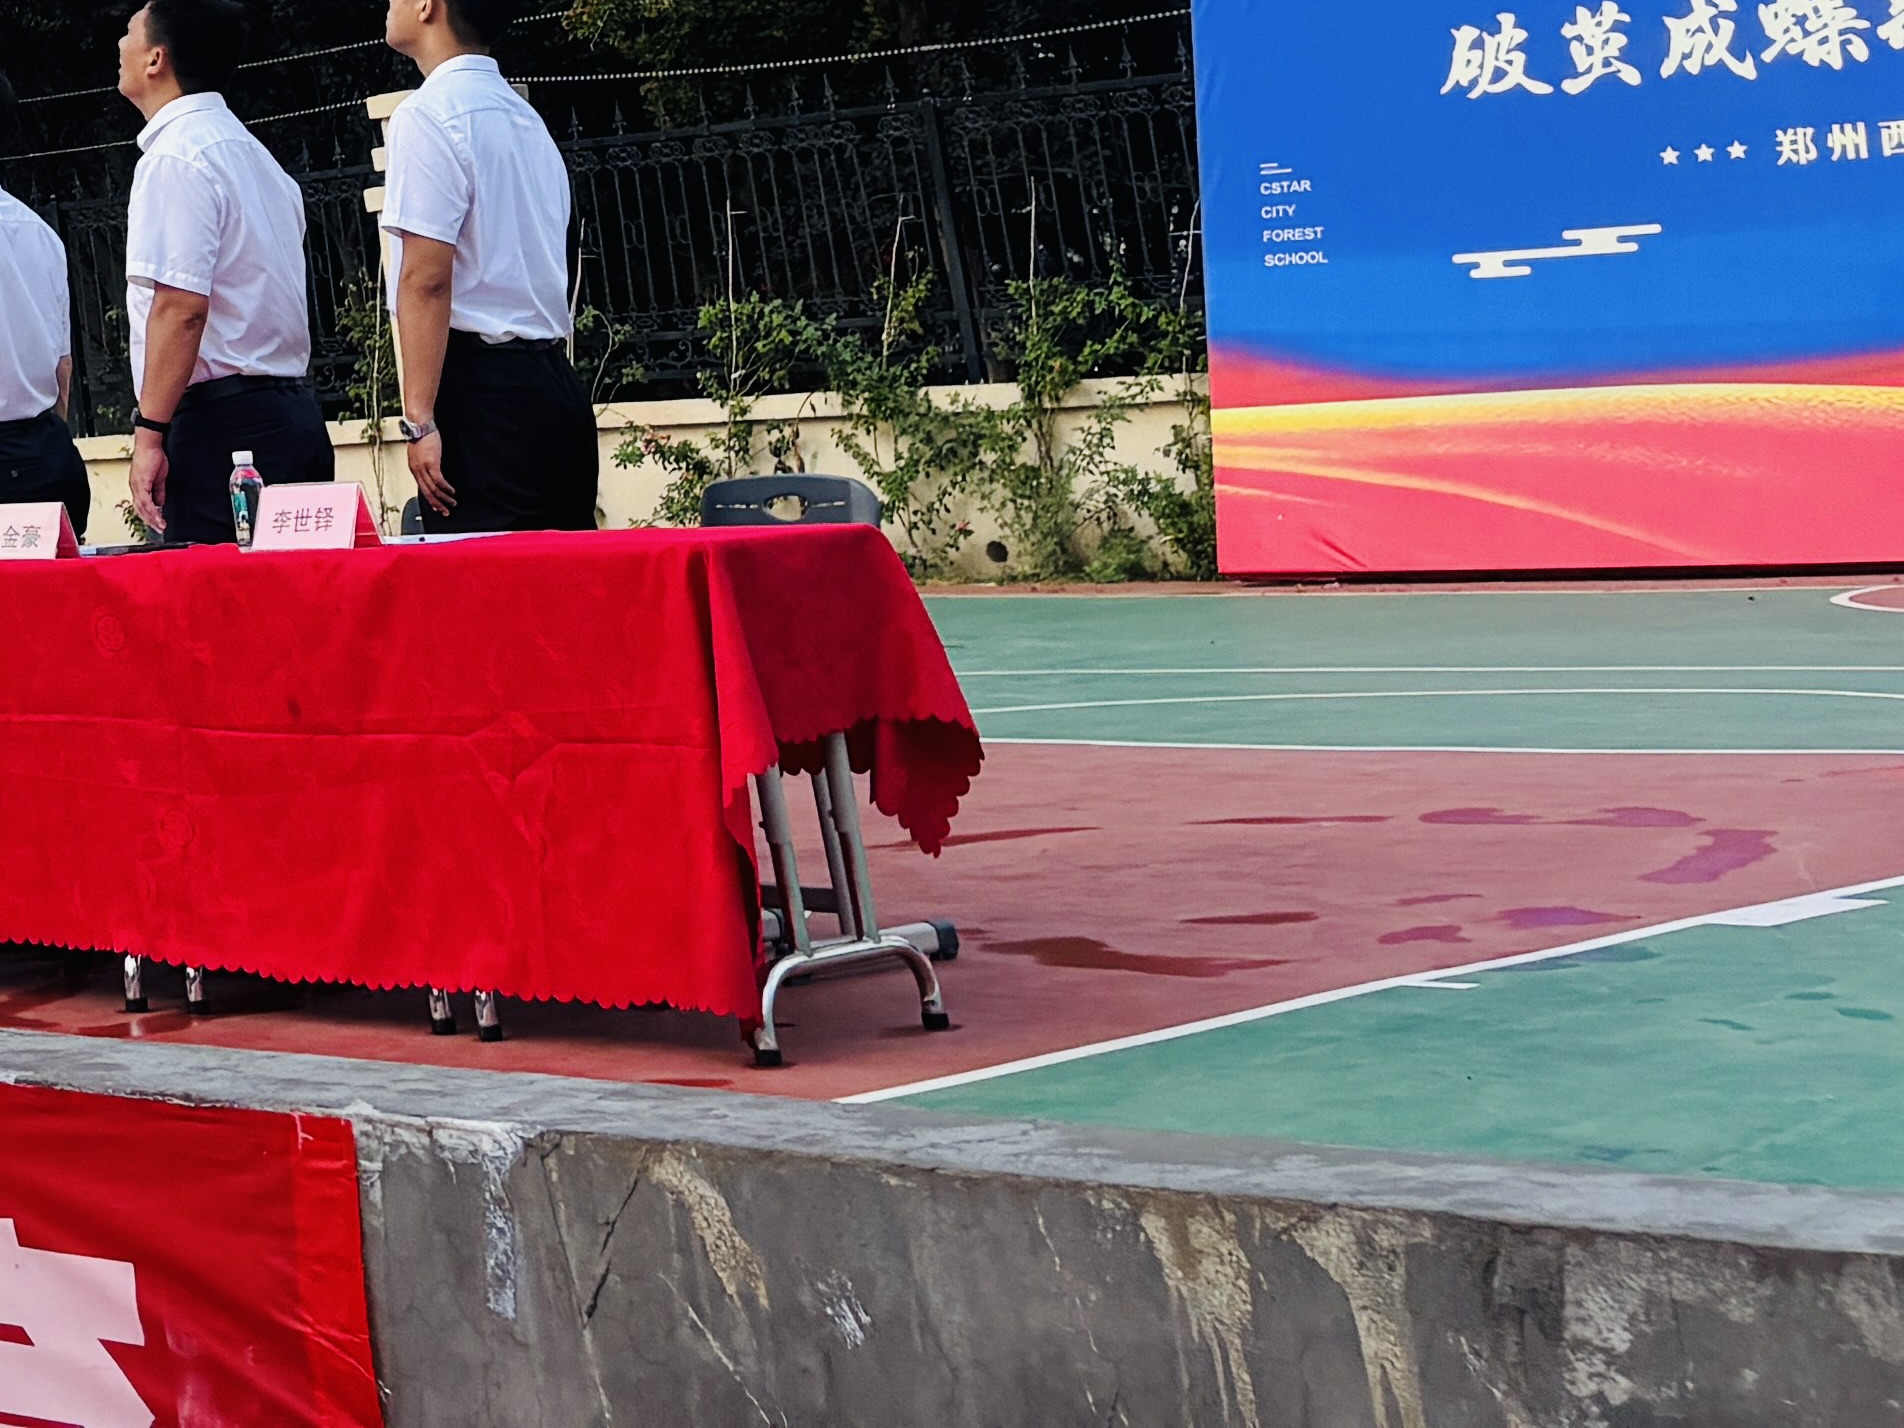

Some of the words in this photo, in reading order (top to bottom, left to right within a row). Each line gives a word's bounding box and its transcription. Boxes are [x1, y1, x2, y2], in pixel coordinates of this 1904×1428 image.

[1260, 180, 1312, 195] CSTAR
[1261, 204, 1296, 219] CITY
[1263, 226, 1324, 242] FOREST
[1264, 251, 1329, 267] SCHOOL
